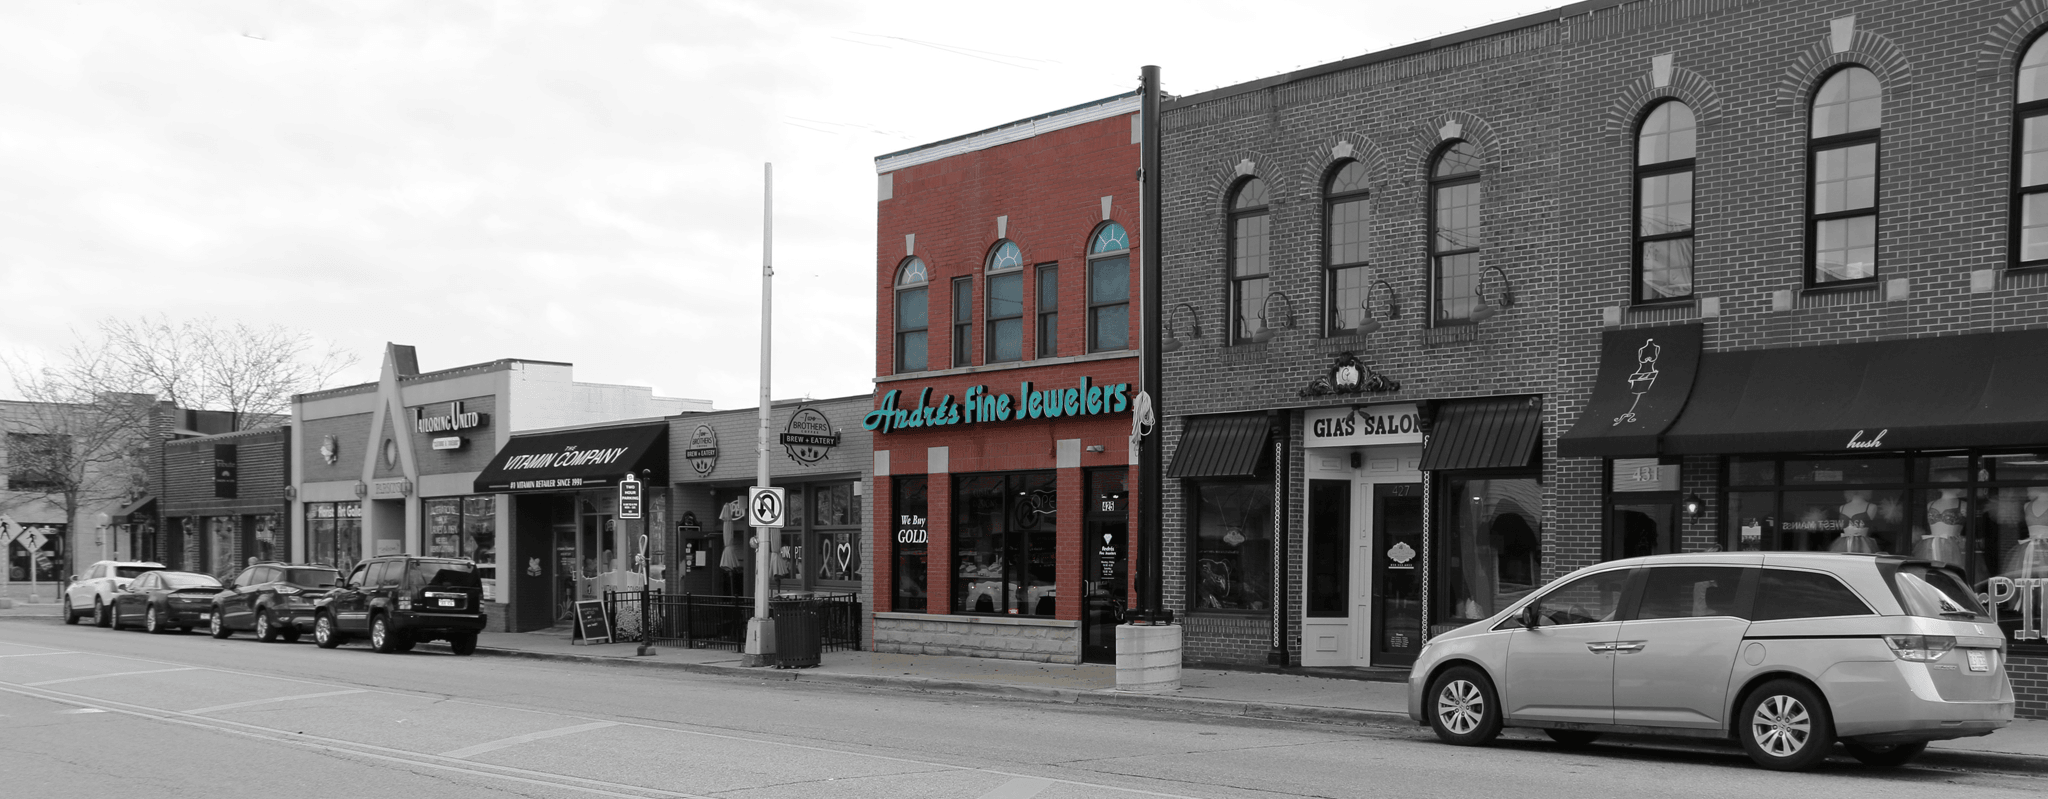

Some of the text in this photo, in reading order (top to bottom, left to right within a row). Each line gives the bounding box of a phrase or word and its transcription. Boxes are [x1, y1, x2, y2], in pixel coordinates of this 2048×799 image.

[965, 385, 1011, 424] Fine
[1016, 376, 1127, 420] Jewelers
[413, 401, 478, 433] TAILORING UNLTD
[793, 421, 827, 431] BROTHERS
[1313, 417, 1356, 438] GIA'S
[692, 437, 712, 445] BROTHERS
[786, 435, 804, 443] BREW
[810, 436, 834, 445] EATERY
[1846, 429, 1888, 449] hush
[503, 447, 629, 471] VITAMIN COMPANY
[687, 450, 698, 458] BREW
[701, 449, 715, 457] EATERY
[1632, 466, 1660, 482] 431
[510, 478, 583, 489] #1 VITAMIN RETAILER SINCE 1991
[1392, 485, 1410, 497] 427
[1031, 495, 1056, 509] OPE
[1102, 501, 1115, 511] 425
[901, 515, 926, 528] We Buy
